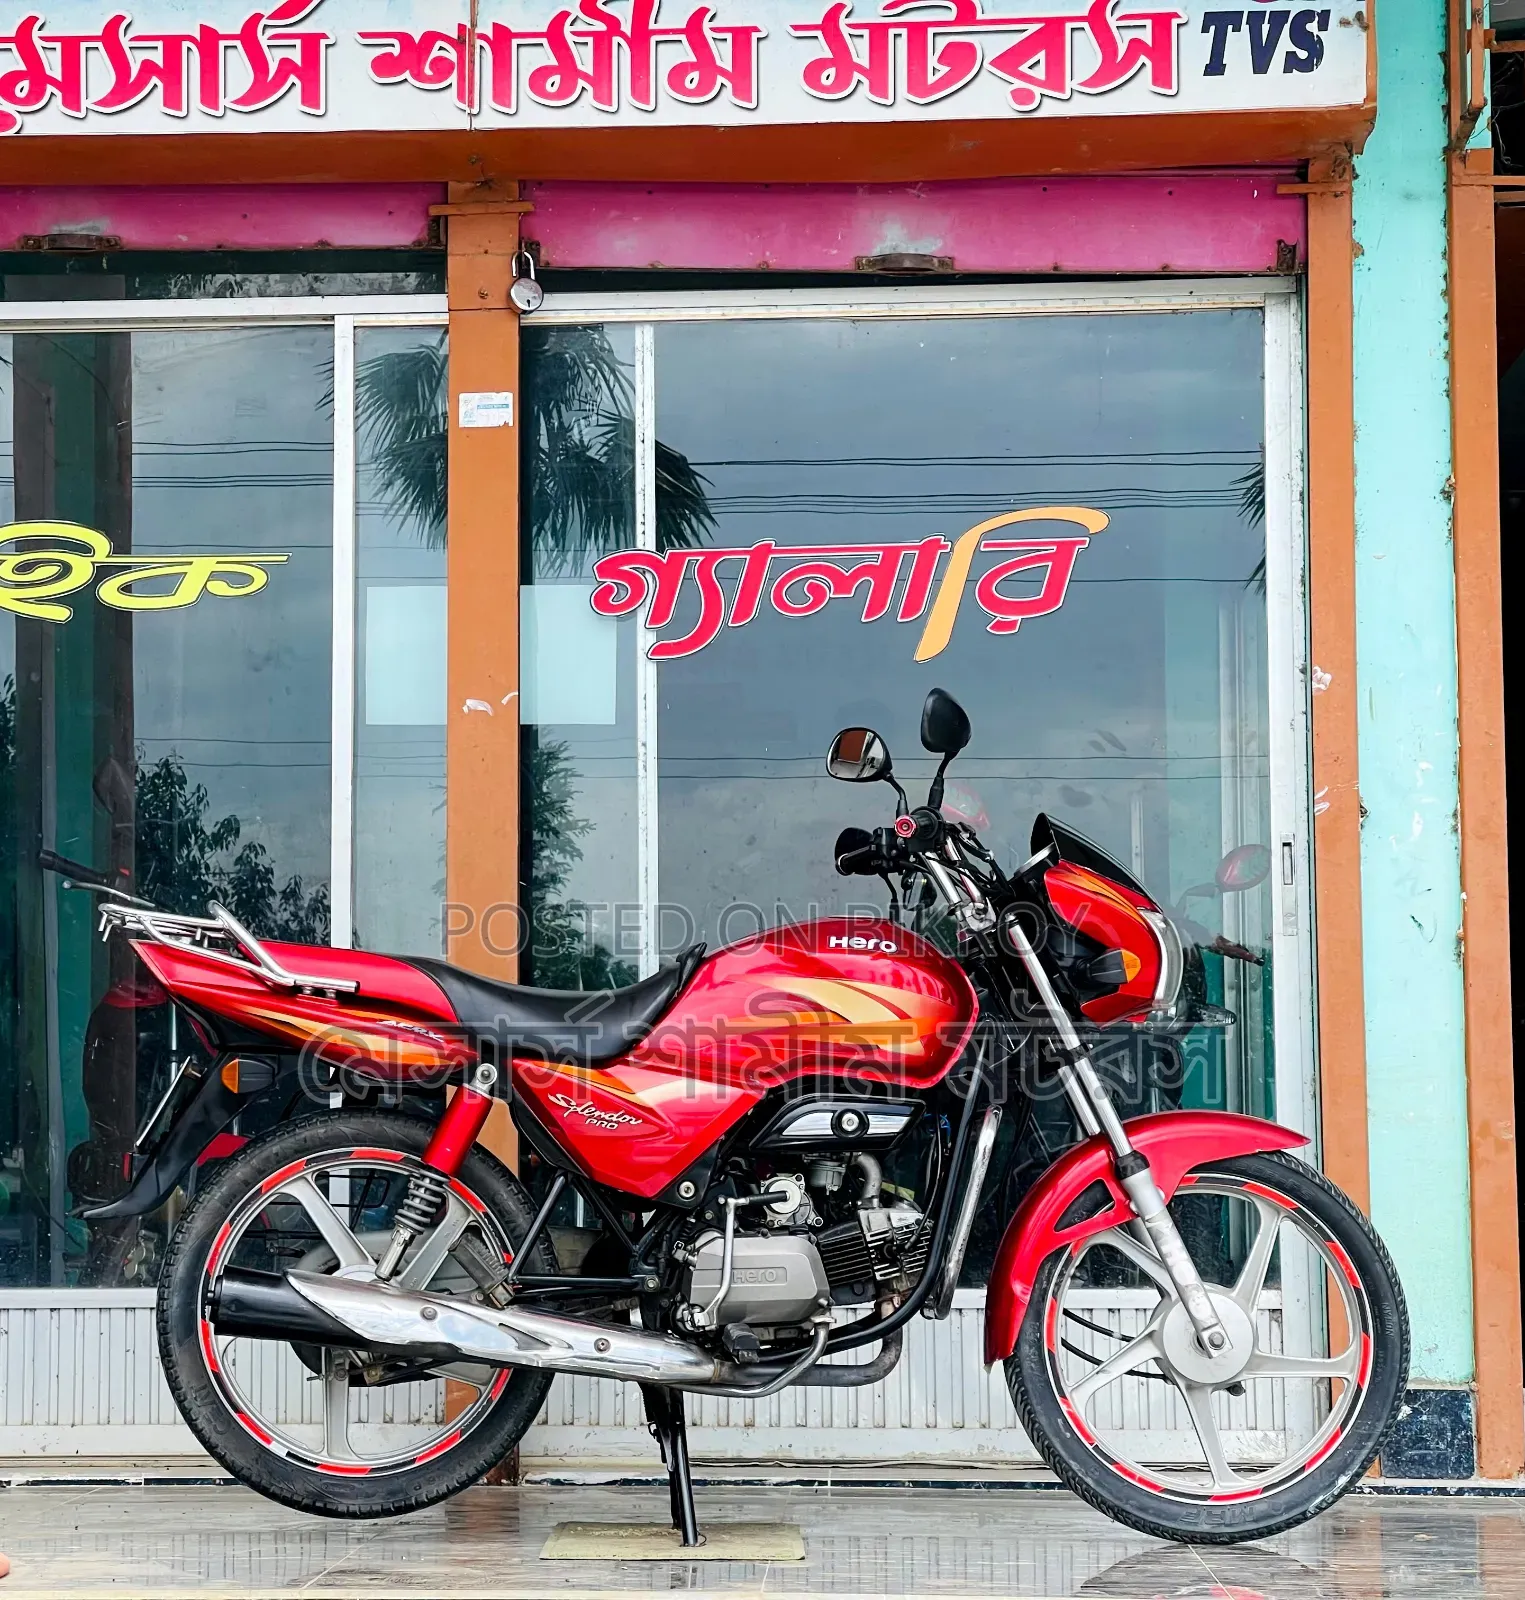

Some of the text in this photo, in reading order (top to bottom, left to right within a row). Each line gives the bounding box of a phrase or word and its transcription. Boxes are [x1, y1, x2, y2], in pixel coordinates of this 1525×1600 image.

[358, 0, 762, 112] শামীম
[791, 0, 1184, 109] মটরস
[1200, 8, 1331, 77] TVS
[590, 506, 1110, 663] গ্যালারি
[828, 935, 898, 953] Hero
[547, 1093, 643, 1125] Splendor
[584, 1118, 619, 1130] PRO
[732, 1268, 778, 1284] Hero
